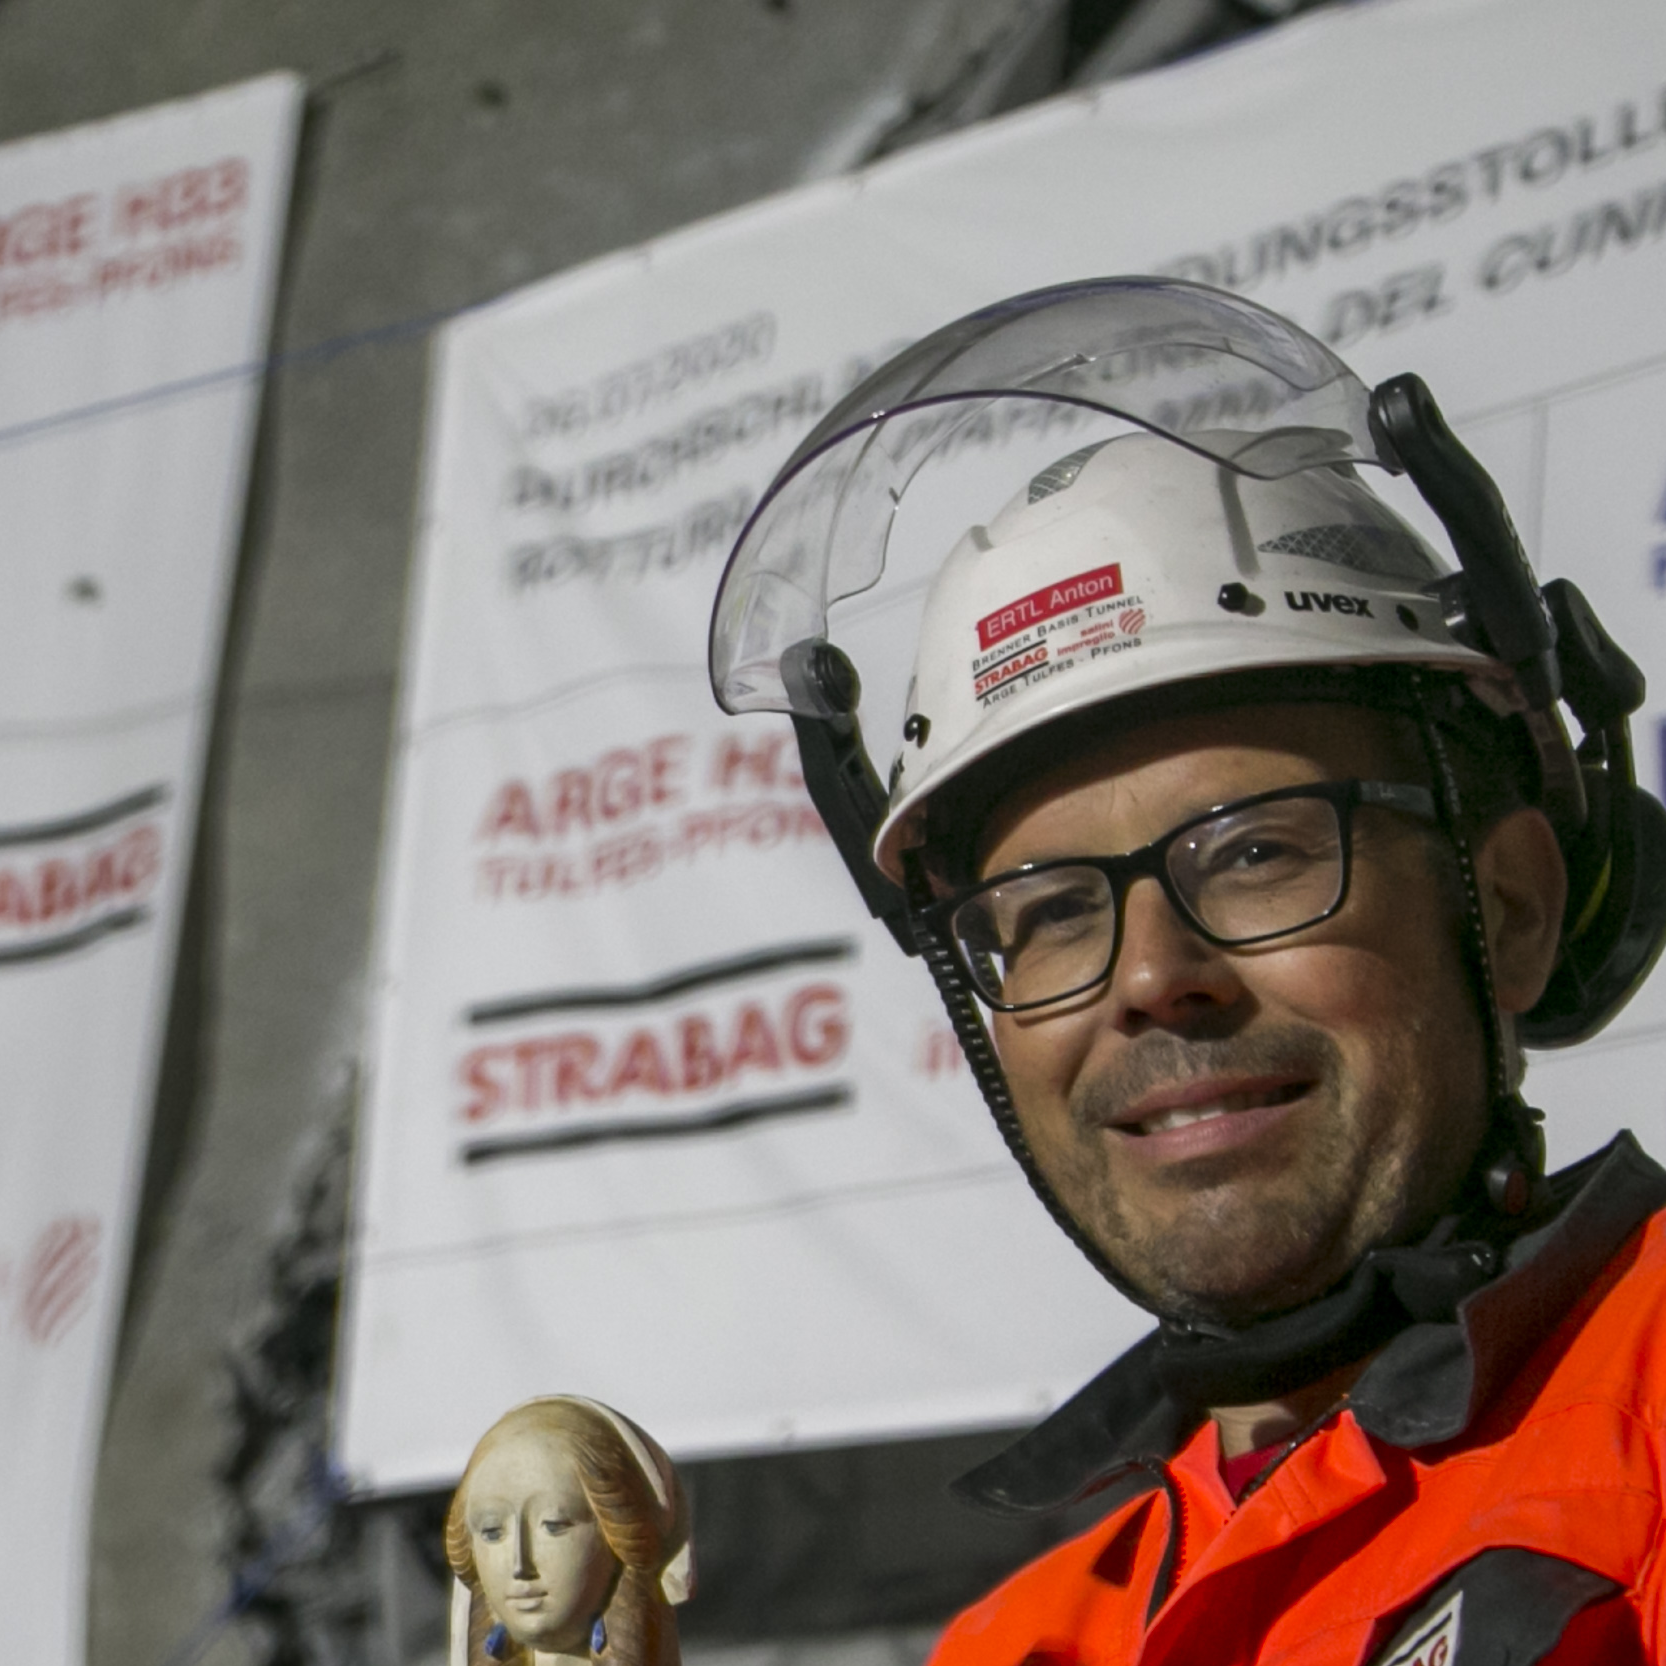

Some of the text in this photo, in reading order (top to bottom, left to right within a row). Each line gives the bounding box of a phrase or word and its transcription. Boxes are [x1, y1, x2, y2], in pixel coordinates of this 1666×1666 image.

[972, 595, 1144, 672] BRENNER BASIS TUNNEL
[986, 574, 1114, 639] ERTL Anton
[1284, 590, 1375, 619] uvex
[974, 646, 1048, 695] STRABAG
[983, 685, 1018, 709] ARGE
[1024, 658, 1074, 687] TULFES
[1090, 637, 1143, 660] PFONS
[476, 732, 805, 842] ARGE H
[476, 800, 833, 900] TULFES-PFON
[456, 984, 851, 1123] STRABAG
